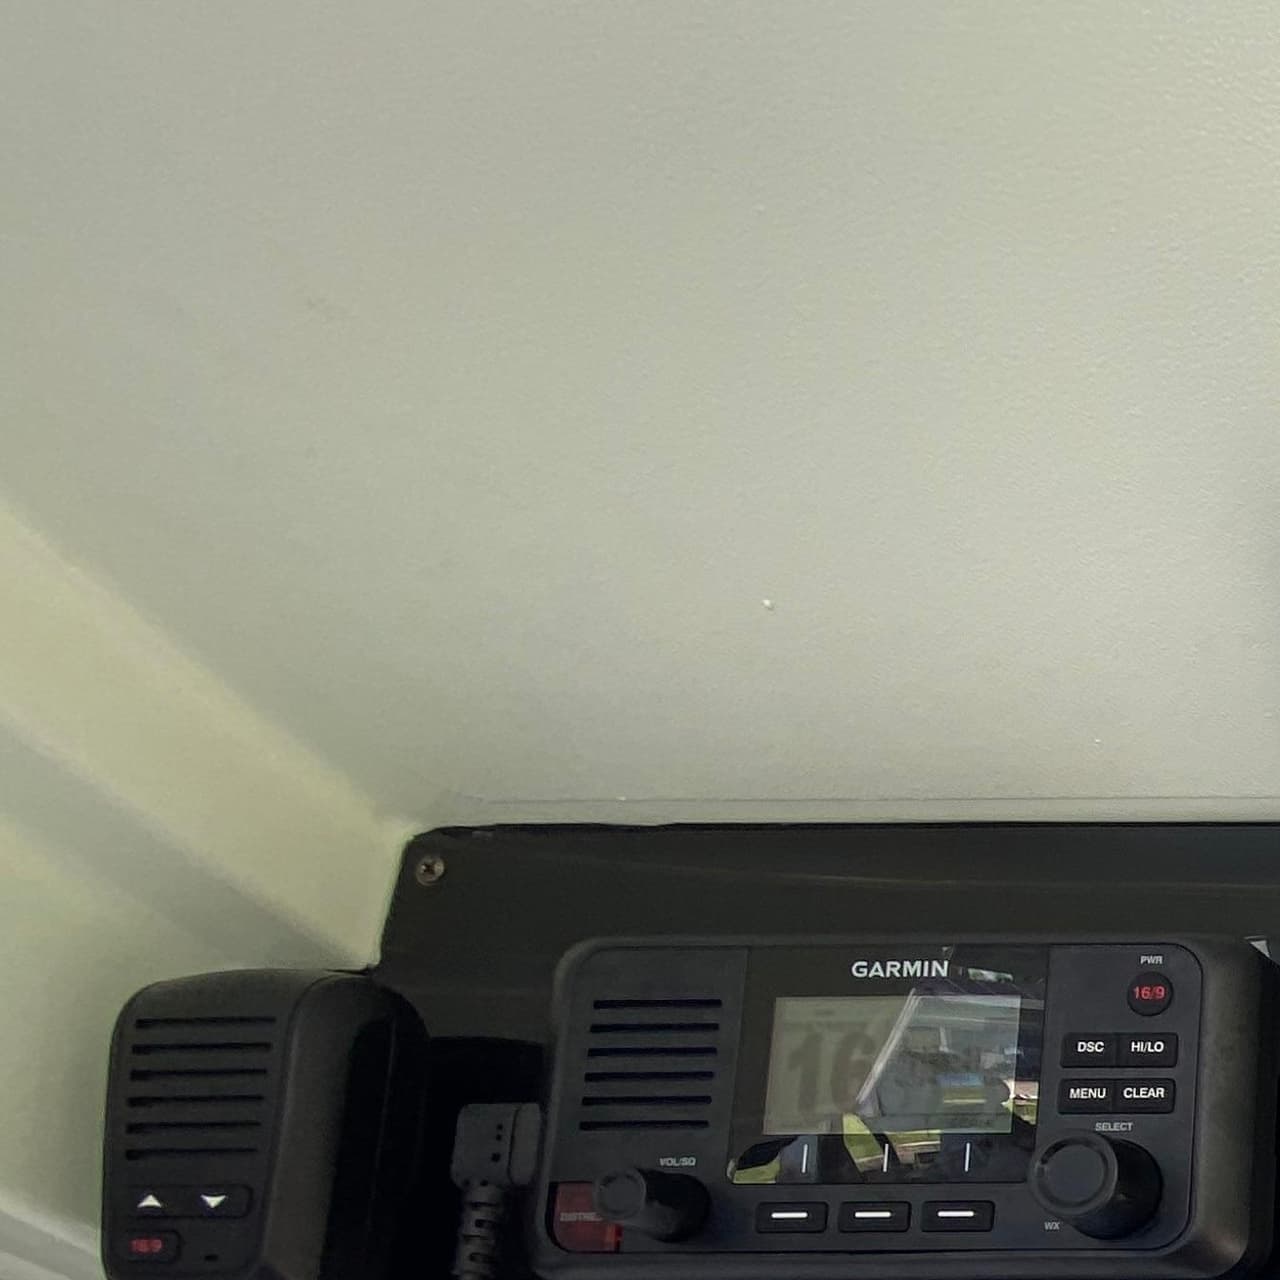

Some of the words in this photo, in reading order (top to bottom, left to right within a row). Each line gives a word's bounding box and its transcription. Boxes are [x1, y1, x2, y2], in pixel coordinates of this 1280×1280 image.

[1140, 956, 1163, 965] PWR
[851, 960, 949, 978] GARMIN
[1133, 986, 1165, 1000] 16/9
[1077, 1041, 1105, 1053] DSC
[1131, 1041, 1165, 1053] HI/LO
[1069, 1088, 1106, 1100] MENU
[1123, 1087, 1165, 1099] CLEAR
[1095, 1122, 1134, 1132] SELECT
[1044, 1221, 1060, 1230] WX
